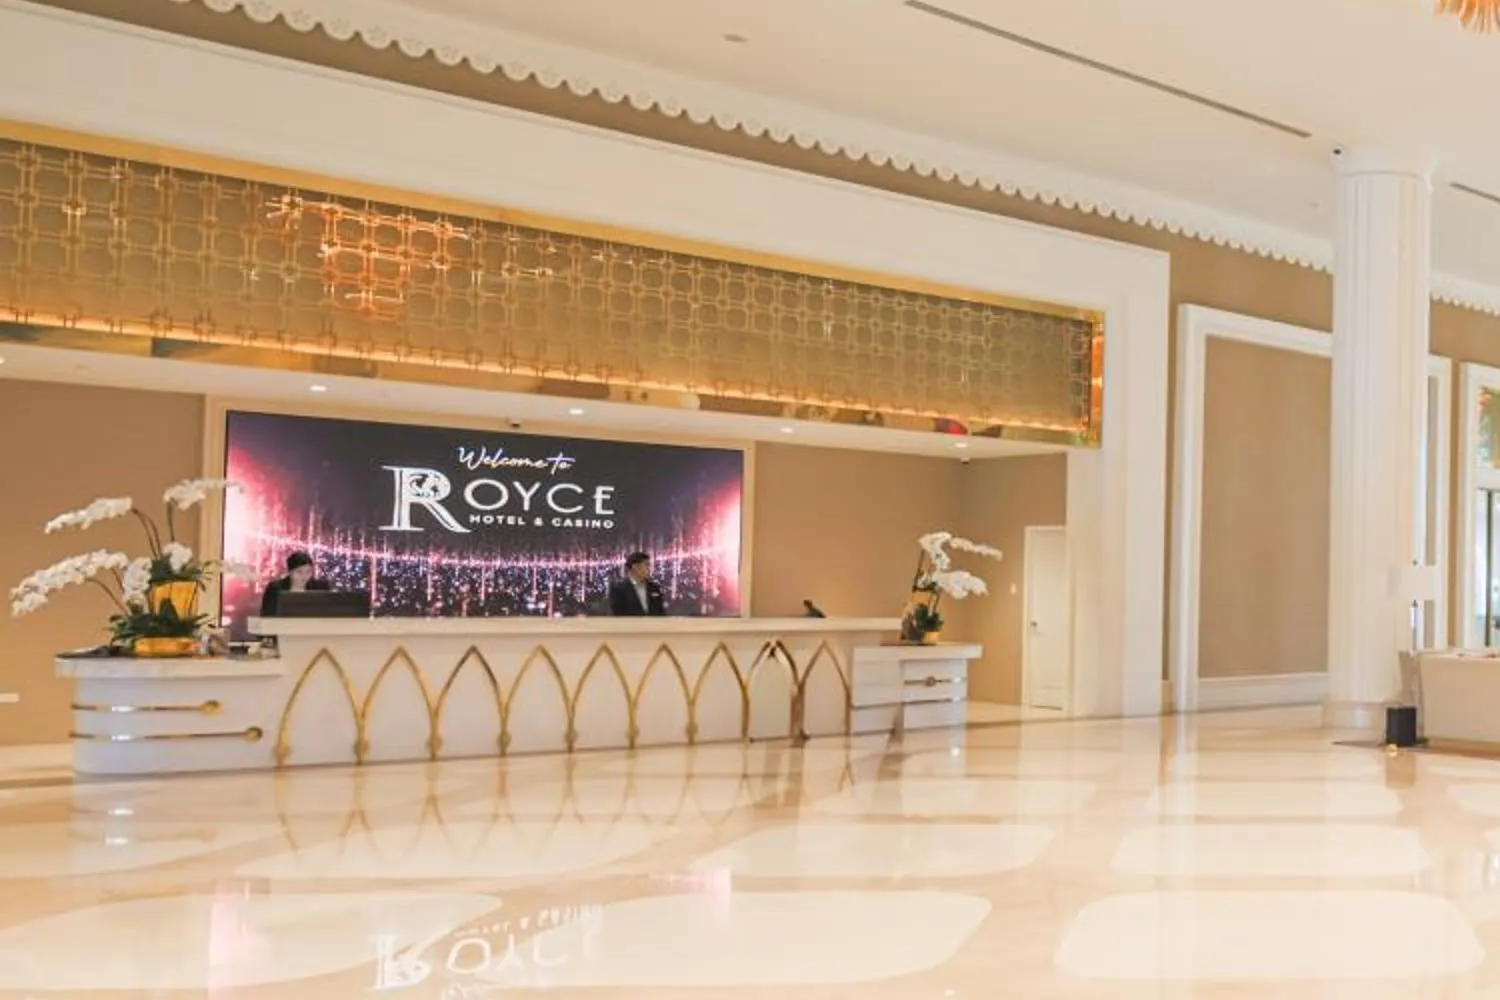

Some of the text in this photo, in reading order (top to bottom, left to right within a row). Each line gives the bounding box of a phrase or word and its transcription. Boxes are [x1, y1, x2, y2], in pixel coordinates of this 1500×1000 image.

[457, 446, 576, 475] Welcome to
[378, 465, 616, 533] ROYCE
[469, 513, 615, 530] HOTEL & CASINO
